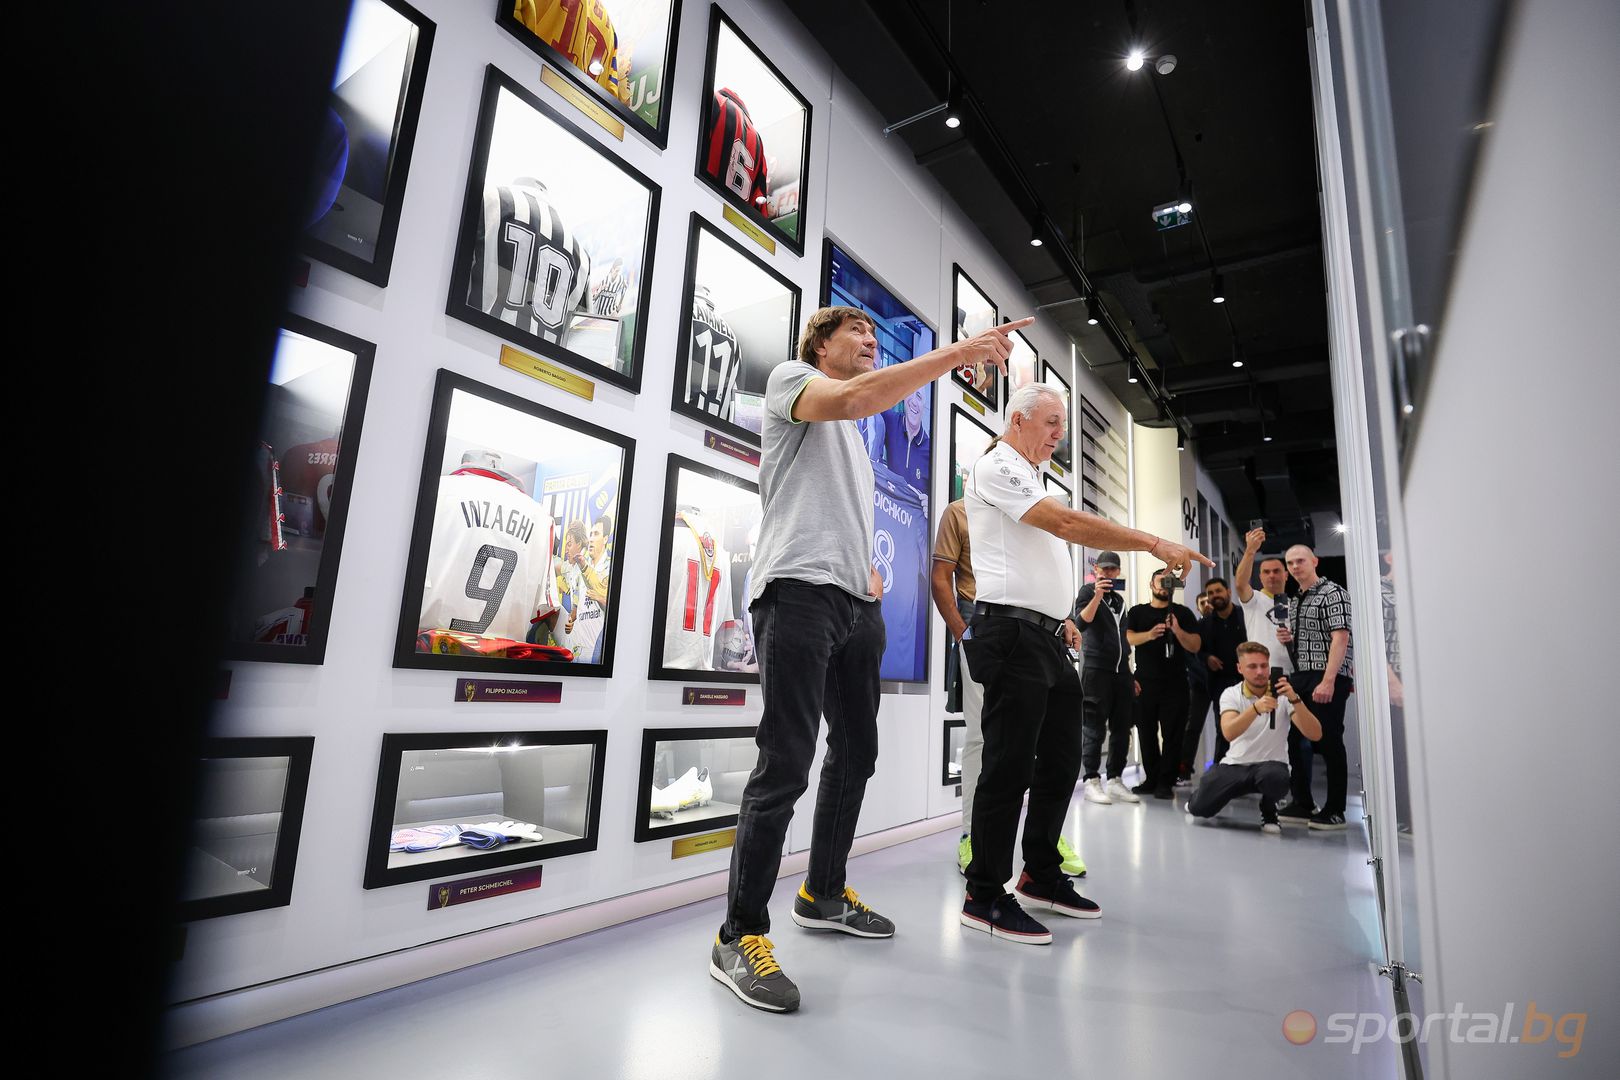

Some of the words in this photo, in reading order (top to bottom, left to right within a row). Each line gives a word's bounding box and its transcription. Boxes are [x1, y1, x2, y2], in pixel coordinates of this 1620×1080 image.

[724, 138, 756, 202] 6
[504, 221, 575, 329] 10
[533, 365, 551, 377] ROBERTO
[695, 328, 732, 402] 11
[460, 500, 535, 545] INZAGHI
[448, 543, 519, 635] 9
[872, 529, 895, 594] 8
[485, 687, 505, 695] FILIPPO
[459, 886, 478, 895] PETER
[478, 879, 514, 892] SCHMEICHEL
